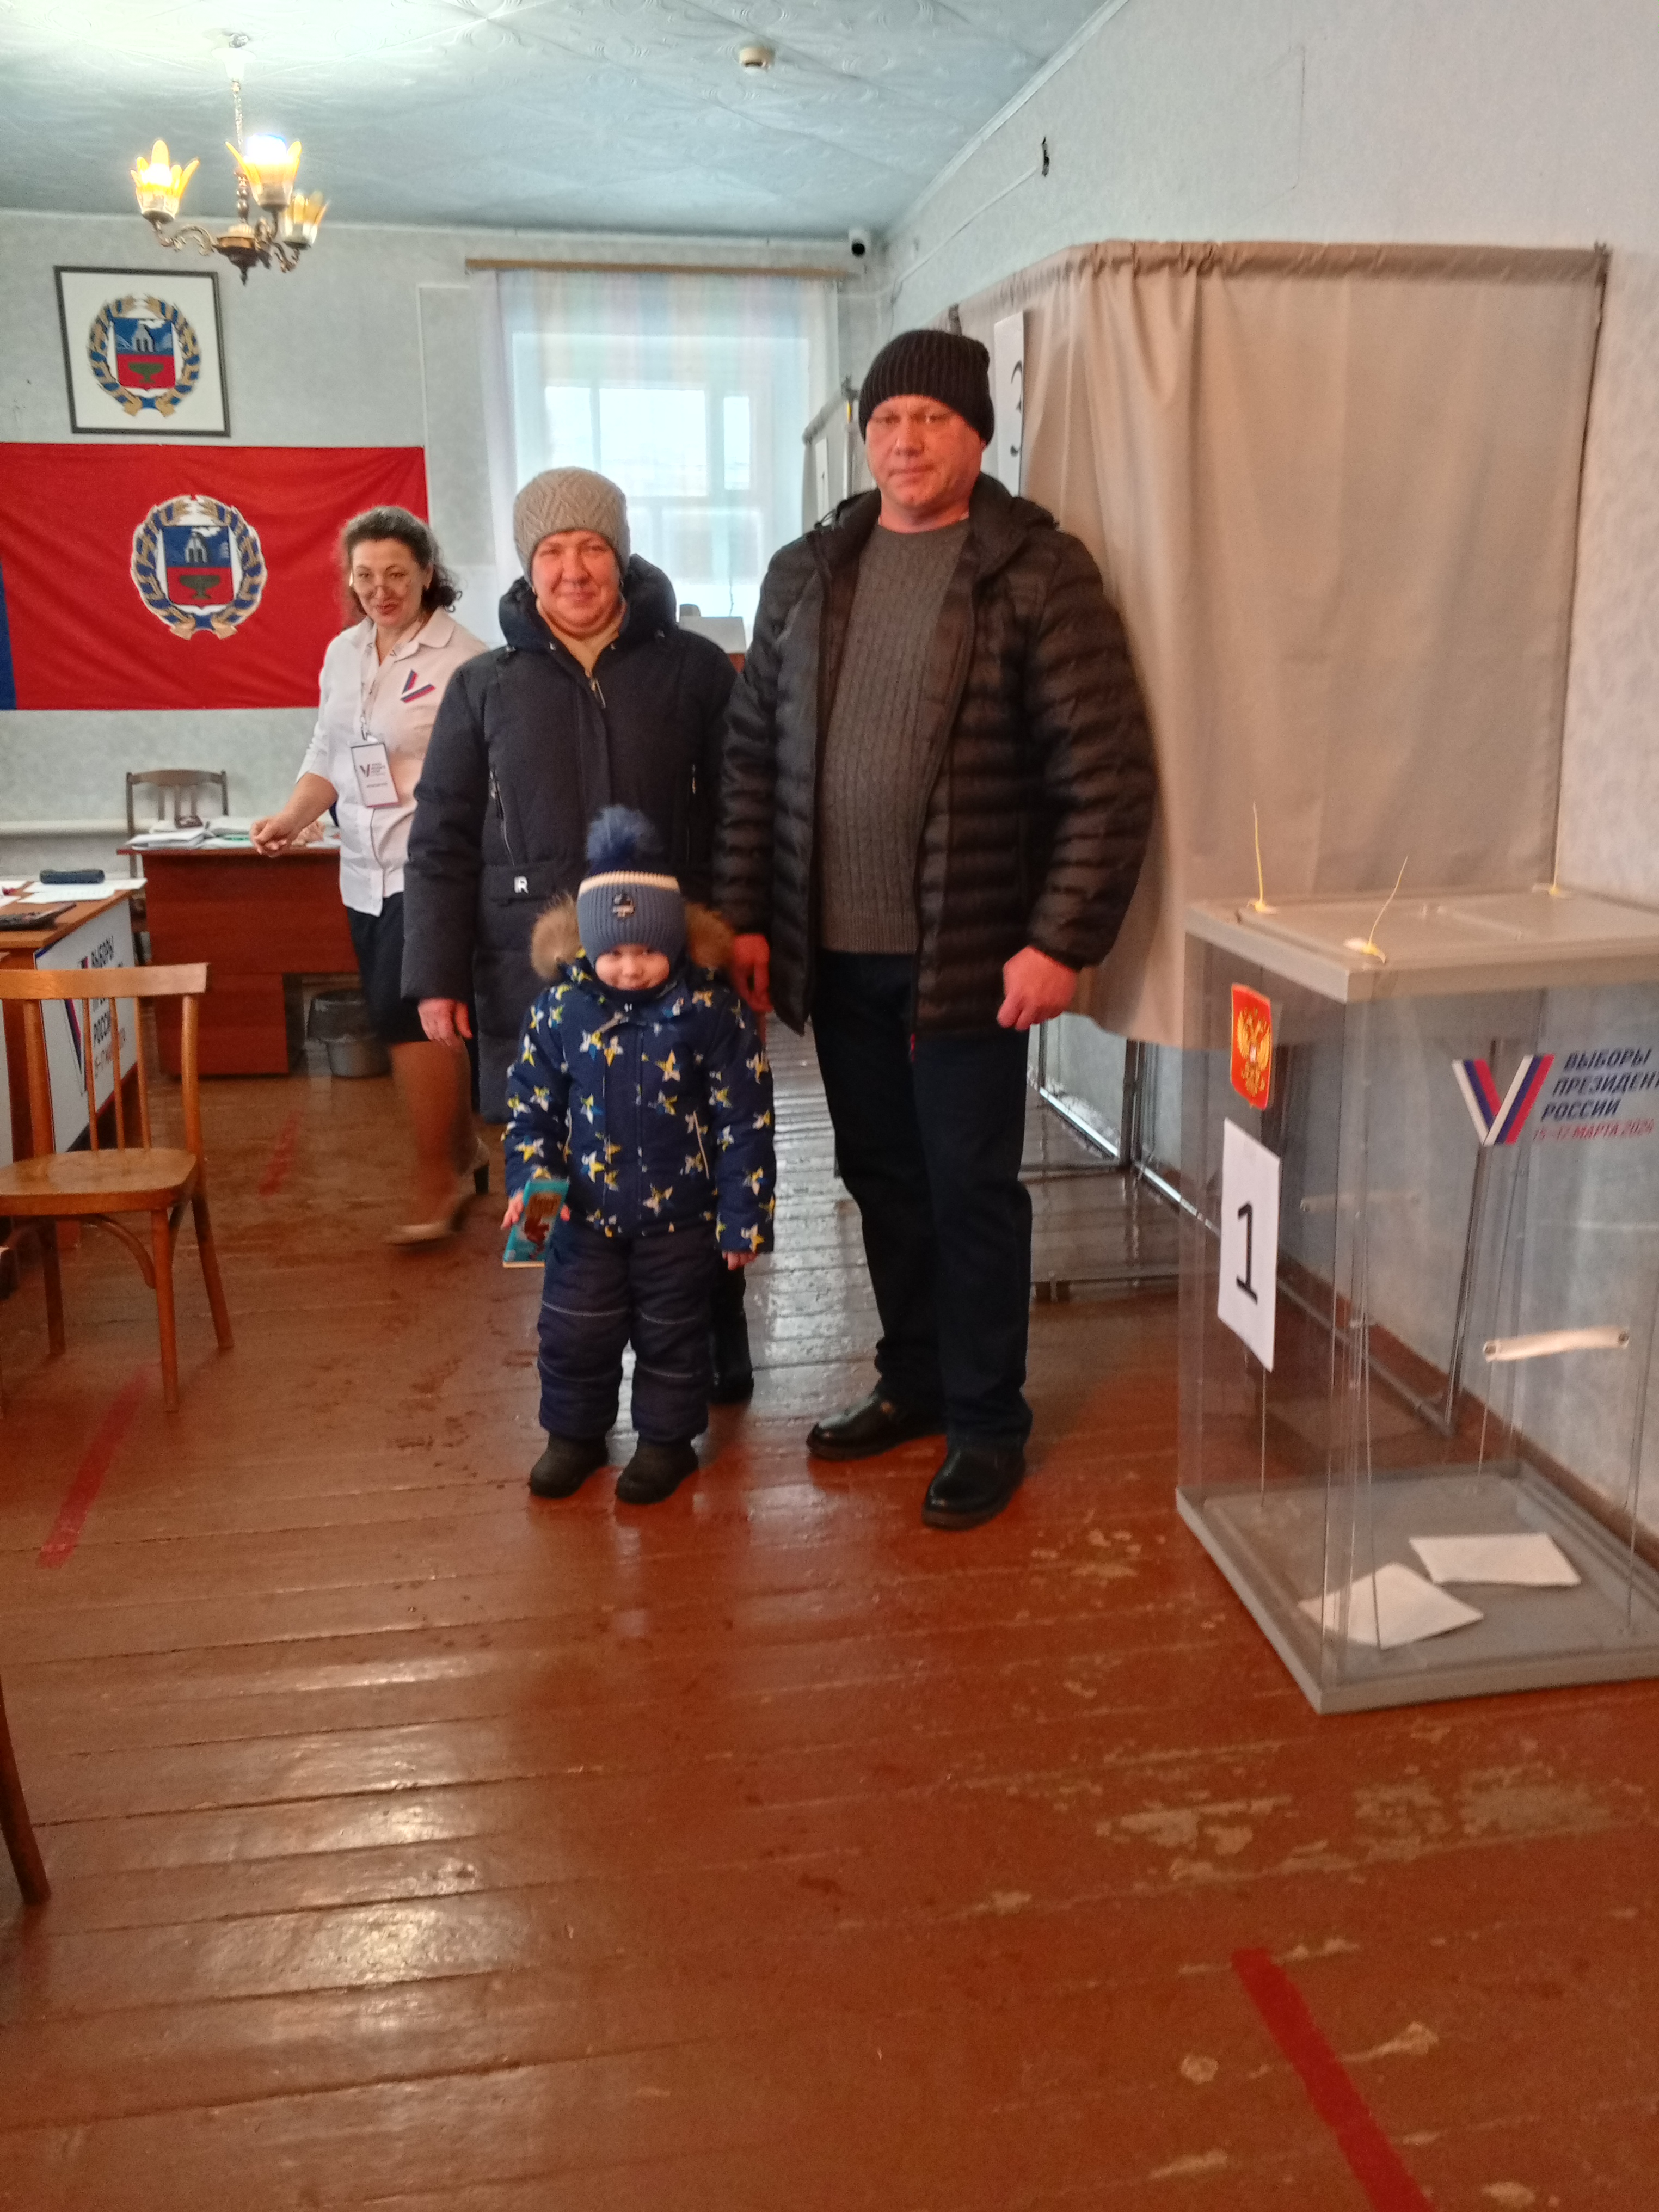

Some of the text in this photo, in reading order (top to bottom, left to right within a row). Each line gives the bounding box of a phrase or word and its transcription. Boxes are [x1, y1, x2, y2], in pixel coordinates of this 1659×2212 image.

[1563, 1048, 1652, 1071] ВЫБОРЫ
[1540, 1098, 1621, 1122] РОССИИ
[1236, 1201, 1258, 1305] 1
